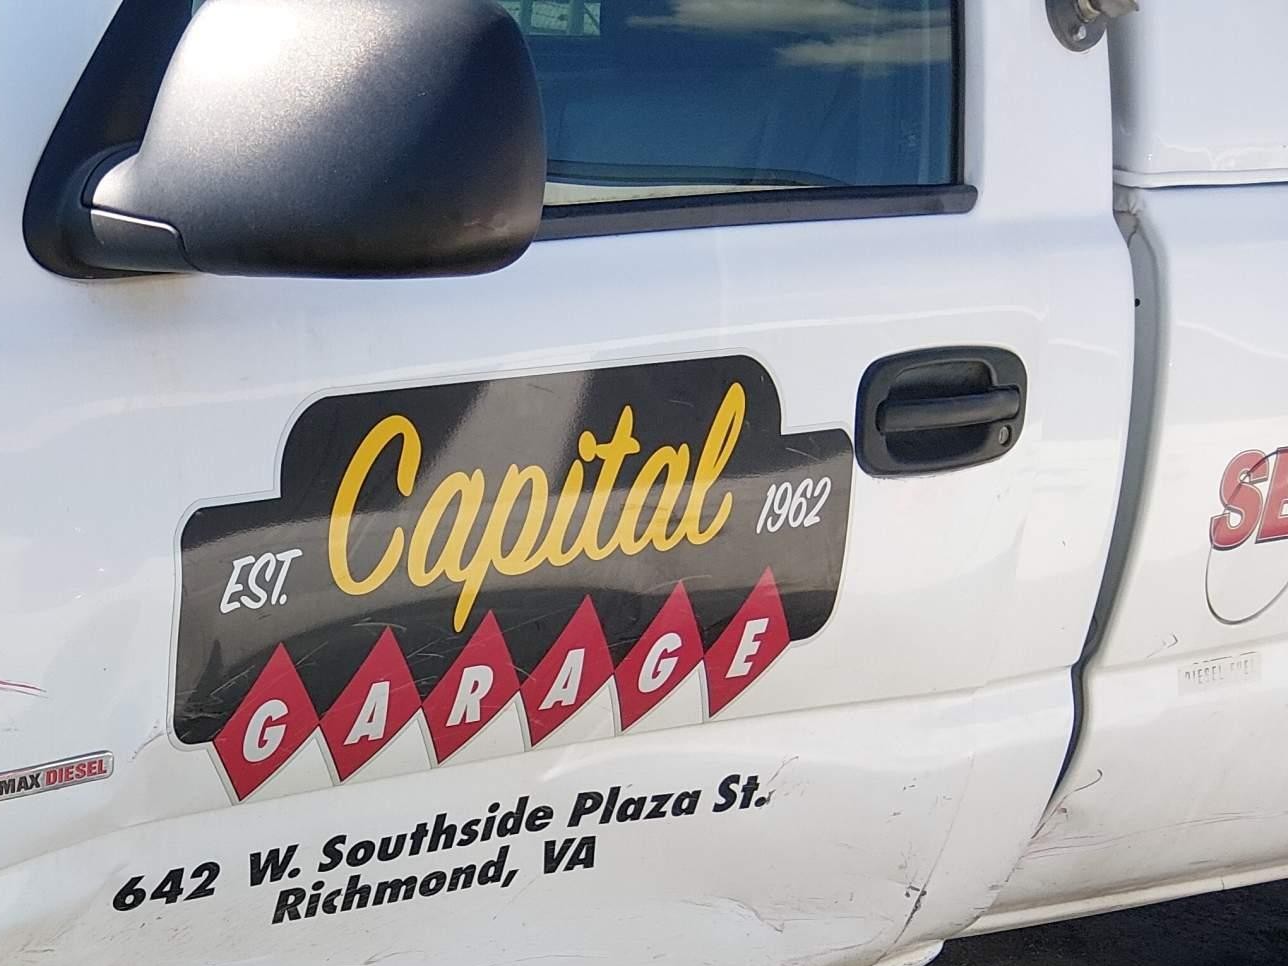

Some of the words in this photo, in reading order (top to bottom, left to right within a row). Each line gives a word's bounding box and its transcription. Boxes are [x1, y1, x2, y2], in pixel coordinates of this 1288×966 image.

[220, 549, 302, 613] EST.
[328, 382, 746, 632] Capital
[756, 477, 831, 534] 1962
[241, 618, 769, 762] GARAGE
[45, 759, 107, 786] DIESEL
[112, 862, 220, 911] 642
[249, 844, 301, 887] W.
[317, 807, 553, 873] Southside
[566, 785, 702, 828] Plaza
[712, 774, 772, 813] St.
[272, 845, 518, 924] Richmond,
[543, 836, 596, 874] VA
